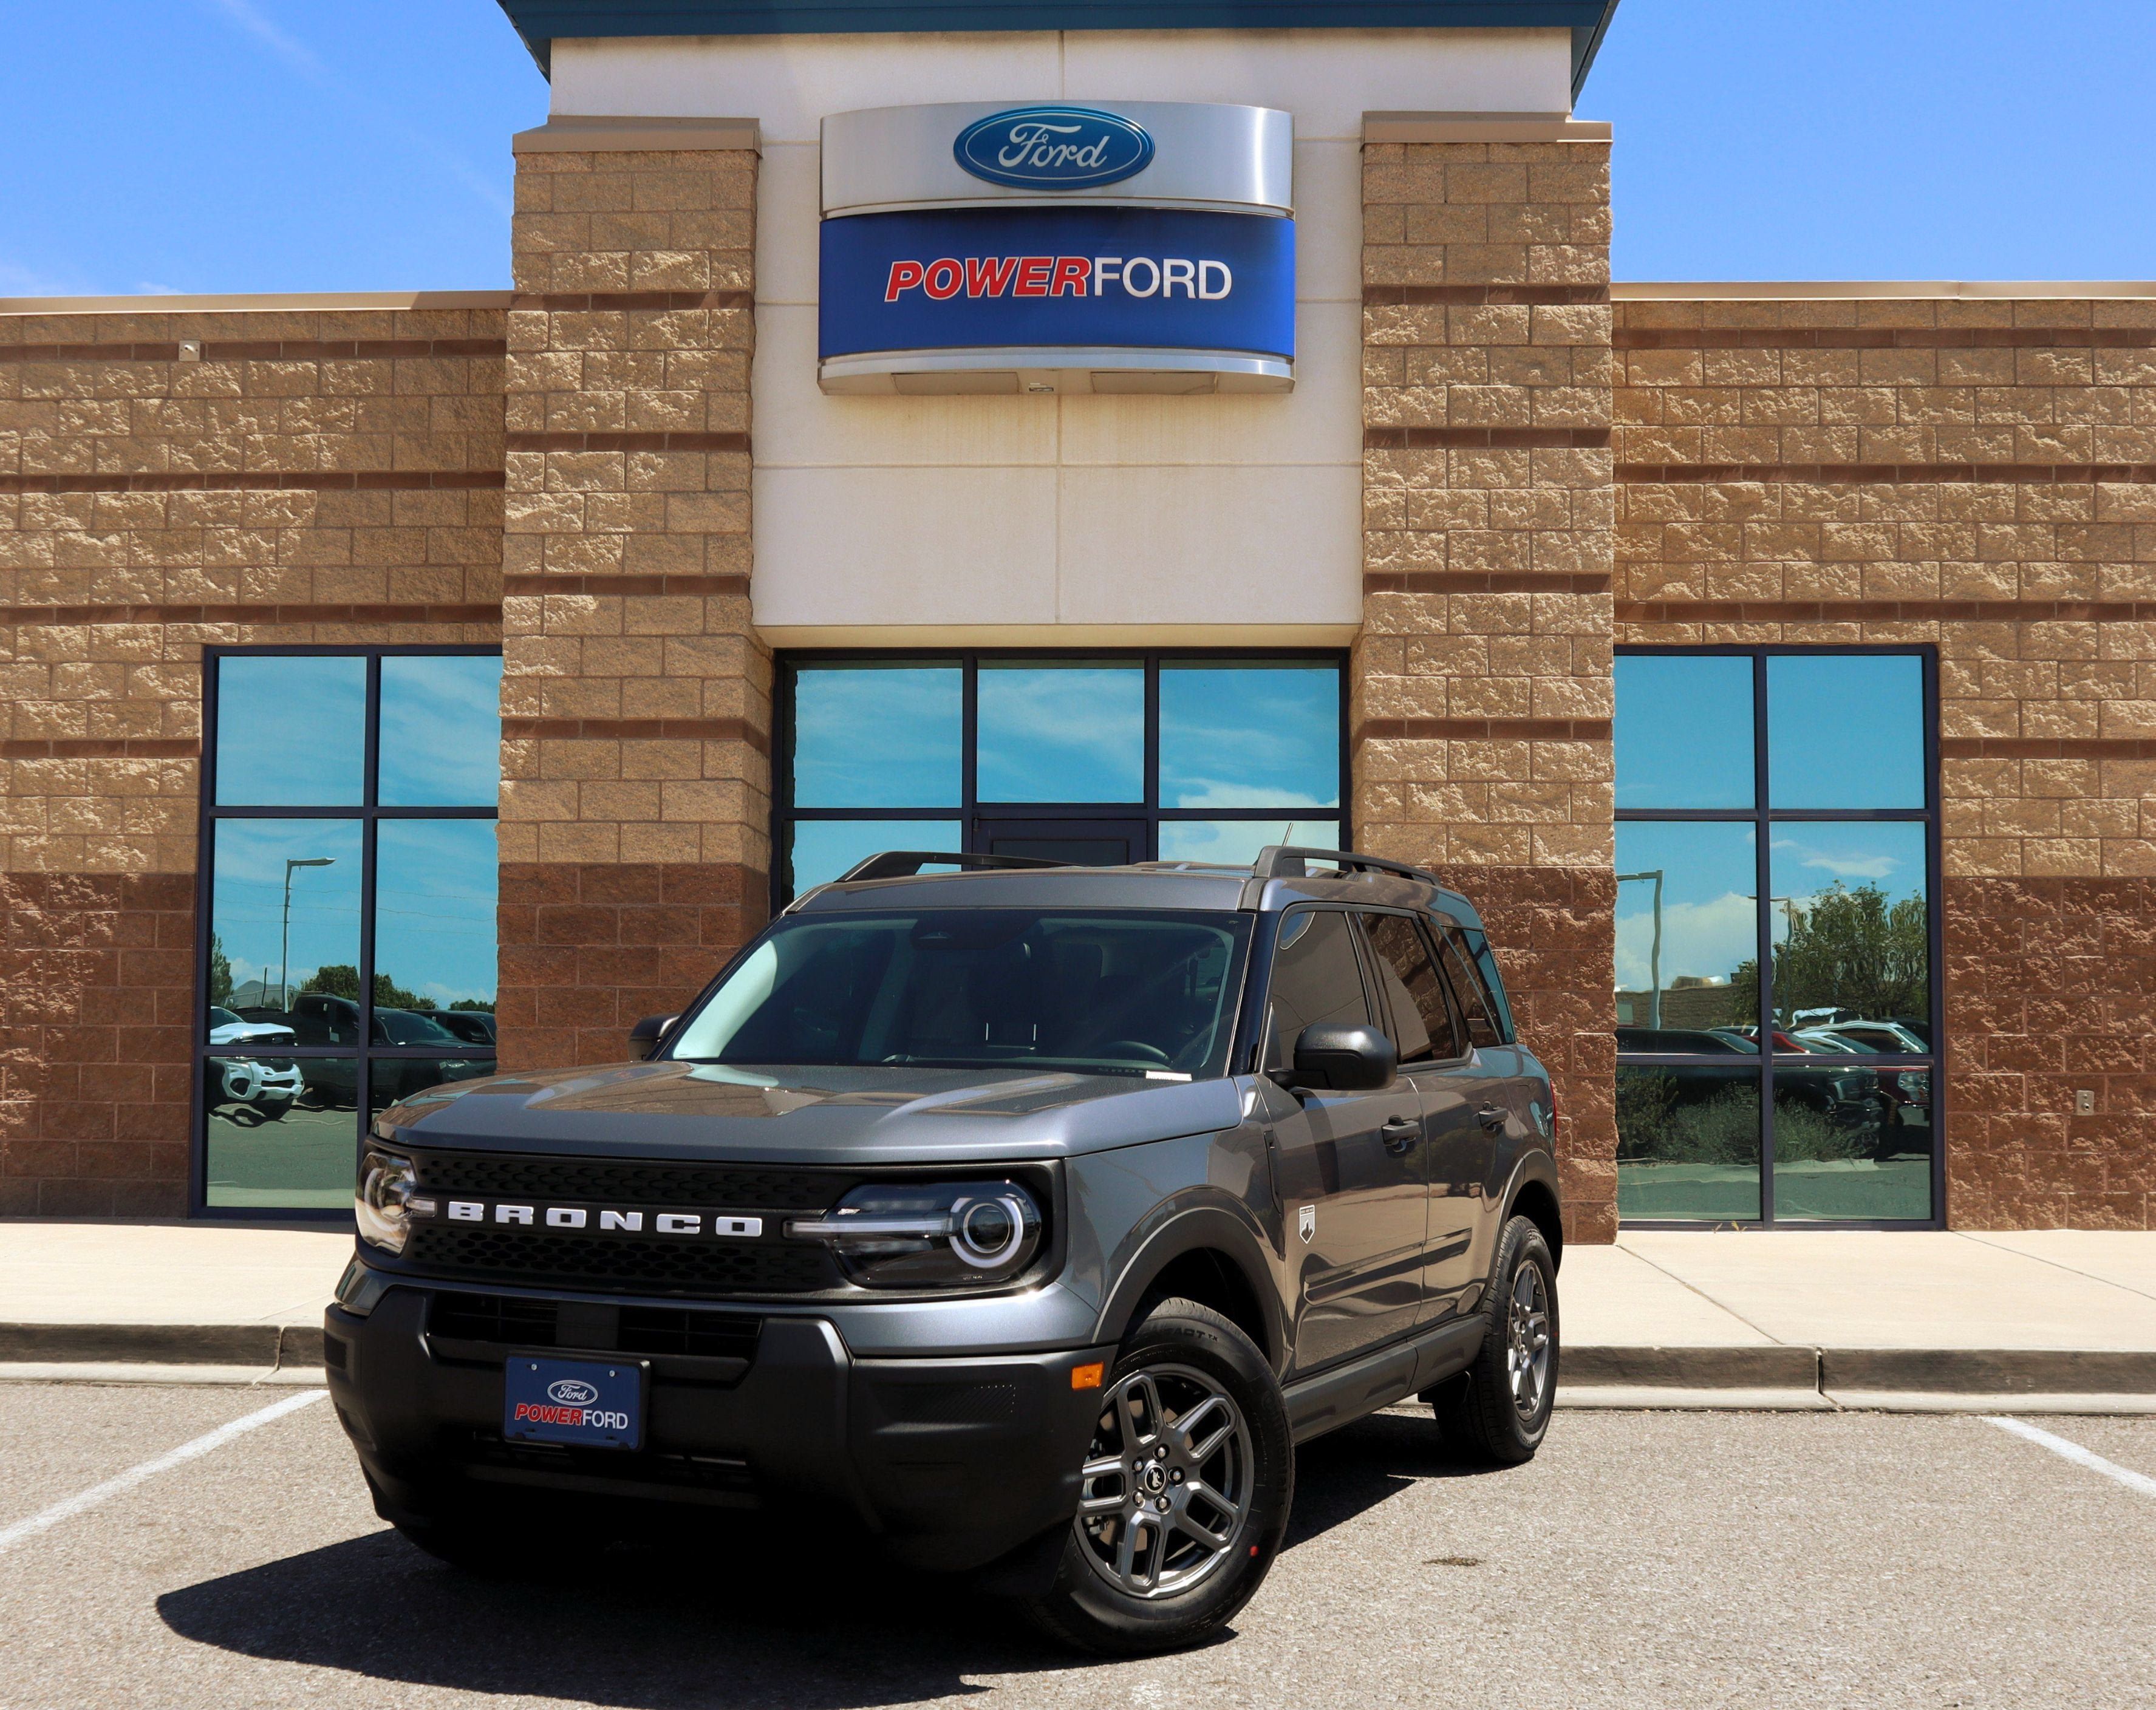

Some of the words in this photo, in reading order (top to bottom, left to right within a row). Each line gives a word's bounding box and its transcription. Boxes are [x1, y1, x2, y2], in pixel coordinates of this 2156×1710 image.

[997, 122, 1110, 169] Ford
[448, 1201, 763, 1237] BRONCO
[558, 1384, 588, 1401] Ford
